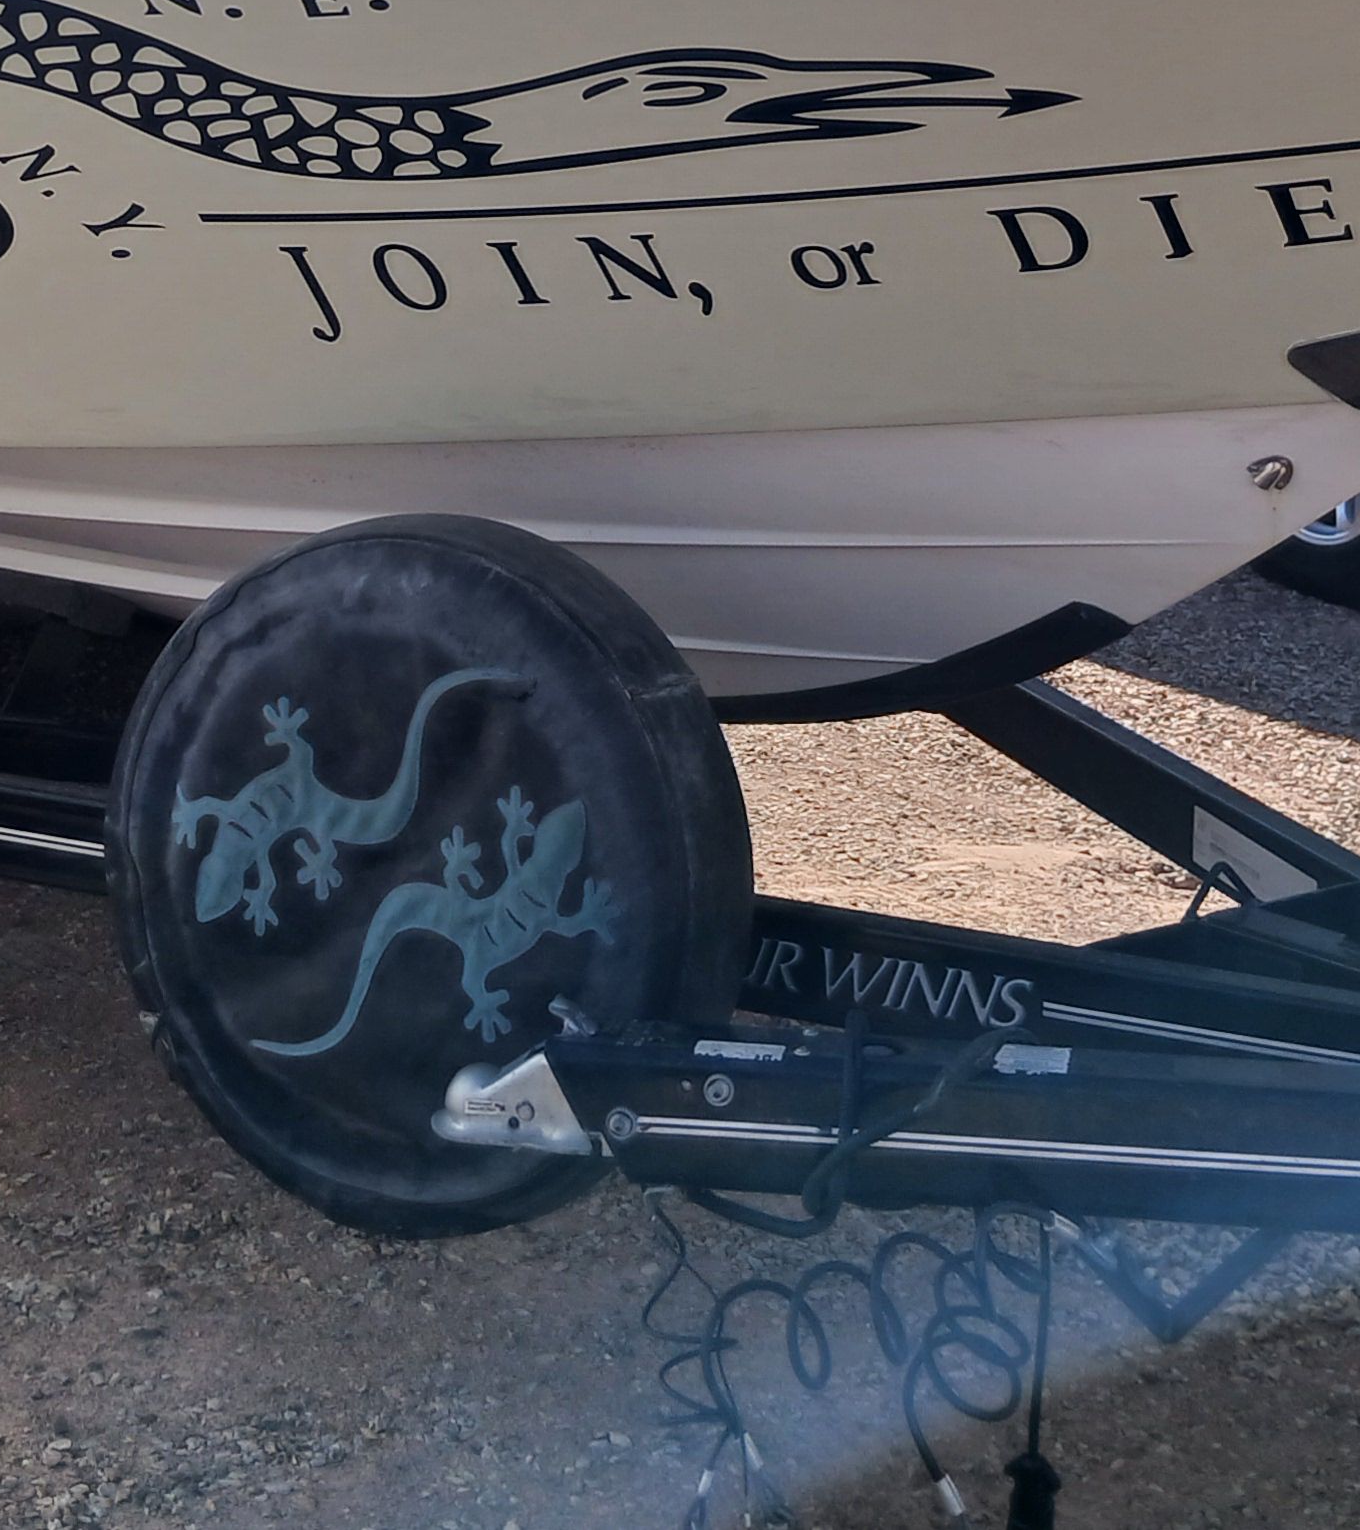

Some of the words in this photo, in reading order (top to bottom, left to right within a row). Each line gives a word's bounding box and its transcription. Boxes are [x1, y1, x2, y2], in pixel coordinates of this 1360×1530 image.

[278, 233, 714, 343] JOIN,
[790, 241, 882, 290] or
[821, 945, 1034, 1028] WINNS
